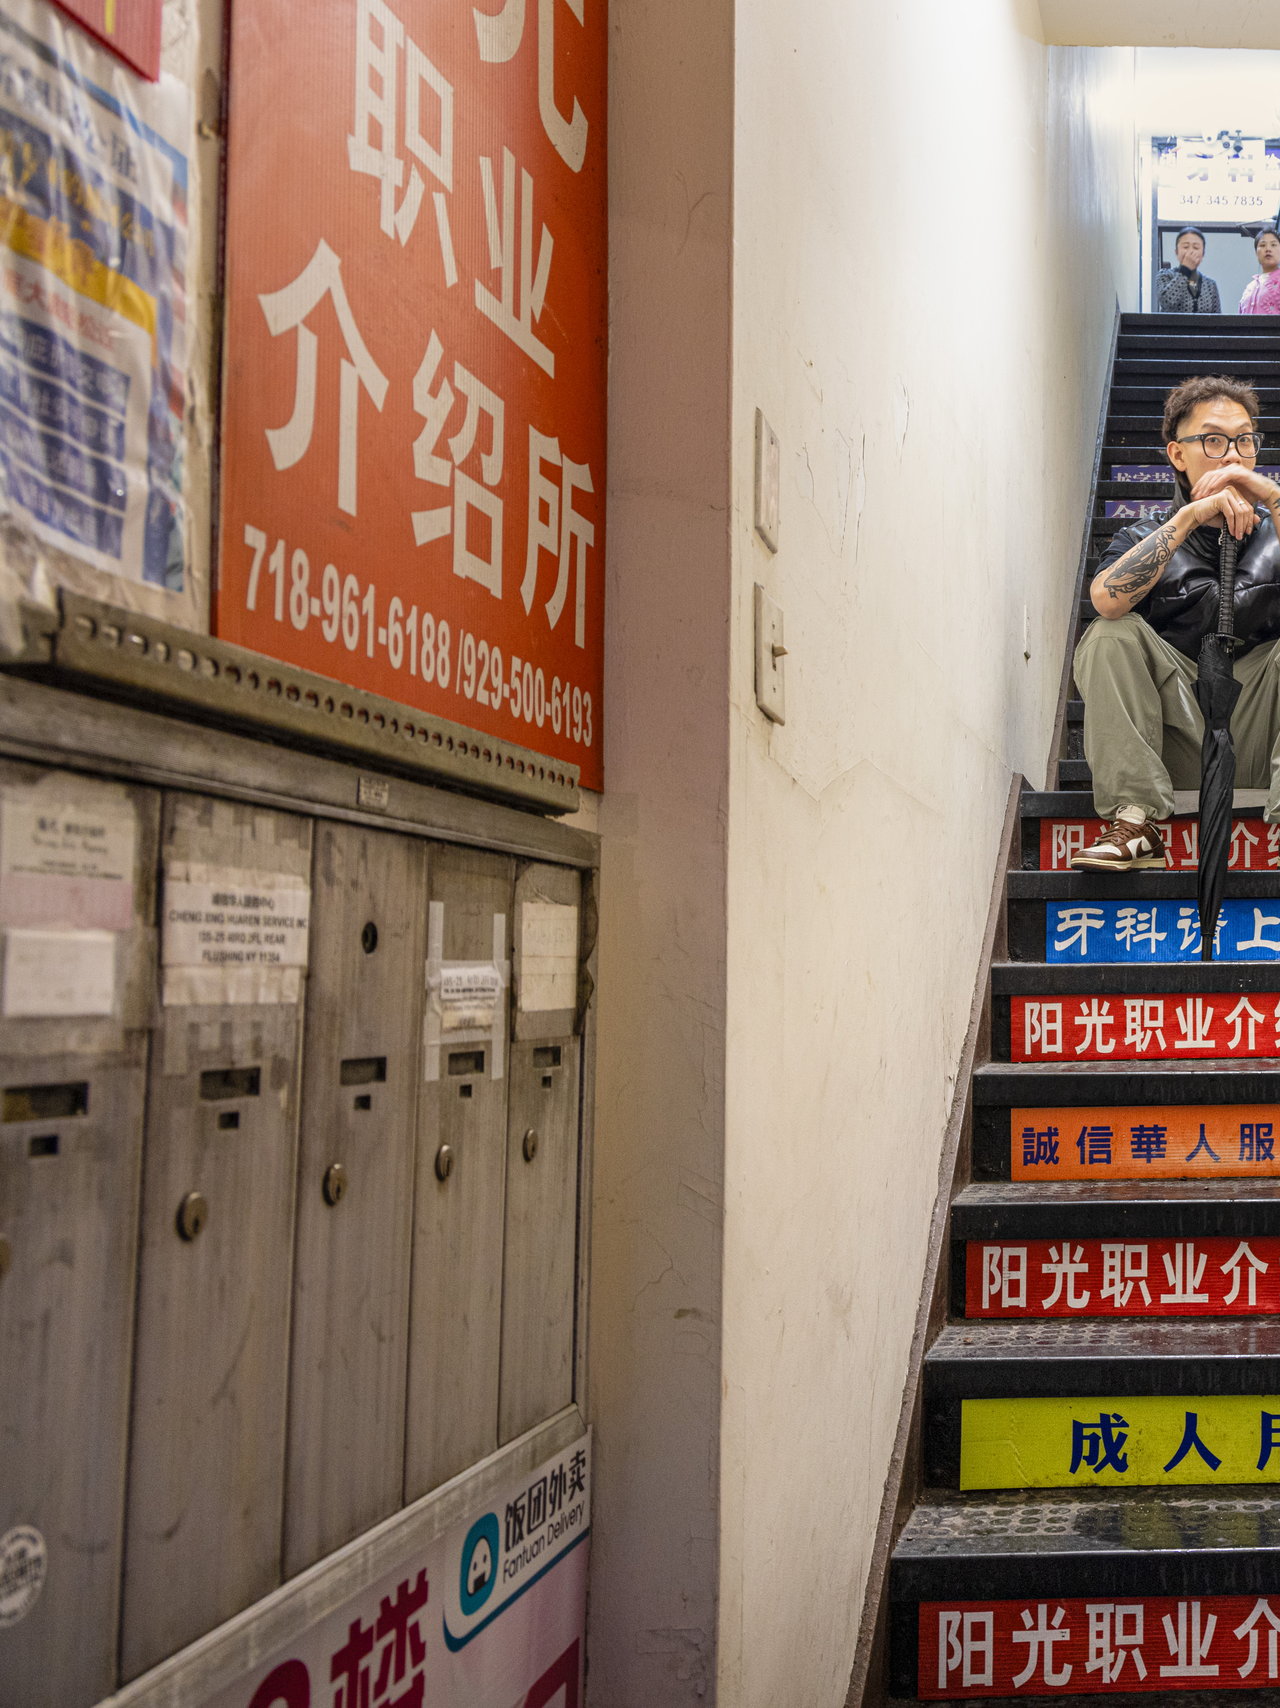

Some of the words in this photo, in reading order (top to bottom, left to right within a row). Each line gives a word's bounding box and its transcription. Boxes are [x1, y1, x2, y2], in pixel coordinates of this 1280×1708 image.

[1180, 195, 1200, 205] 347
[1206, 195, 1229, 206] 345
[1233, 196, 1264, 207] 7835
[258, 237, 595, 650] 介绍所
[243, 523, 451, 690] 718-961-6188
[202, 949, 244, 964] FLUSHING
[263, 915, 295, 929] SERVICE
[503, 1532, 546, 1584] Fantuan
[547, 1499, 585, 1548] Delivery
[504, 1448, 586, 1554] 饭团外卖
